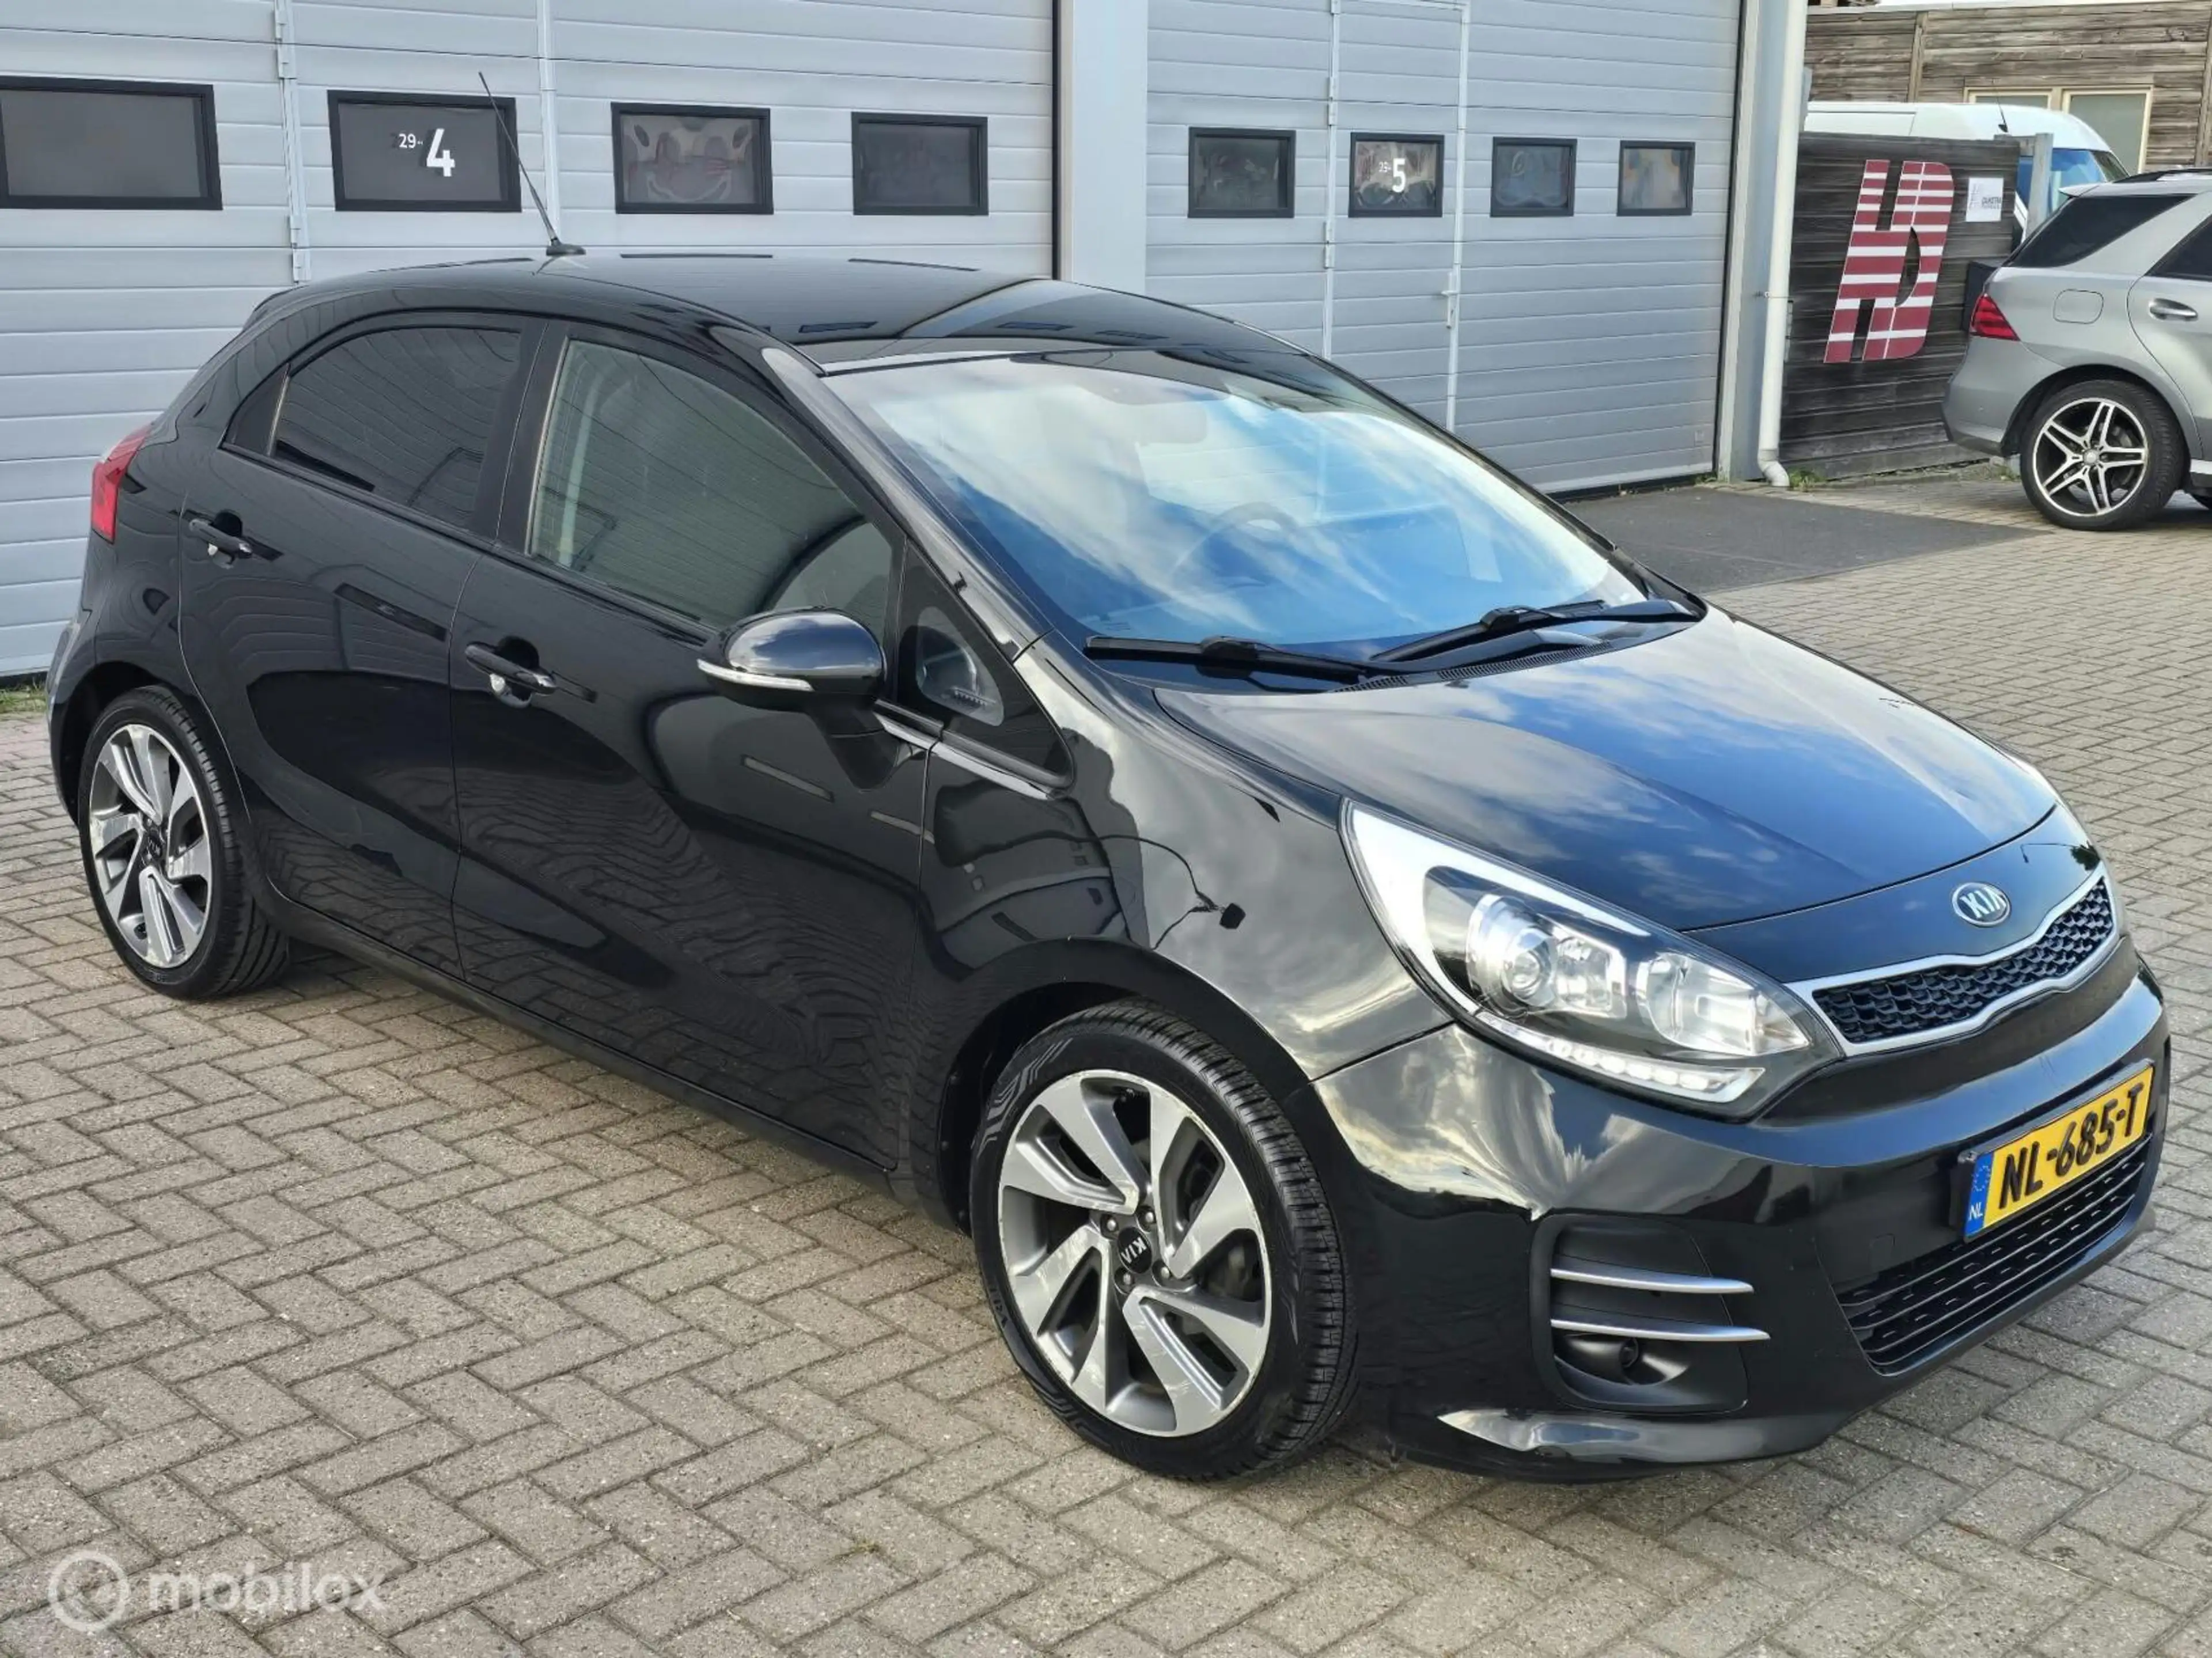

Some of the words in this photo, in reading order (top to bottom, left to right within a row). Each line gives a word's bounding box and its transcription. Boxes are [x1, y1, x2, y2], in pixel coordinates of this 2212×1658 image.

[426, 128, 456, 177] 4
[1393, 158, 1406, 192] 5
[1959, 887, 2007, 919] KIA
[1999, 1082, 2145, 1209] NL-685-T
[1968, 1201, 1983, 1221] NL
[1120, 1236, 1147, 1264] KIA
